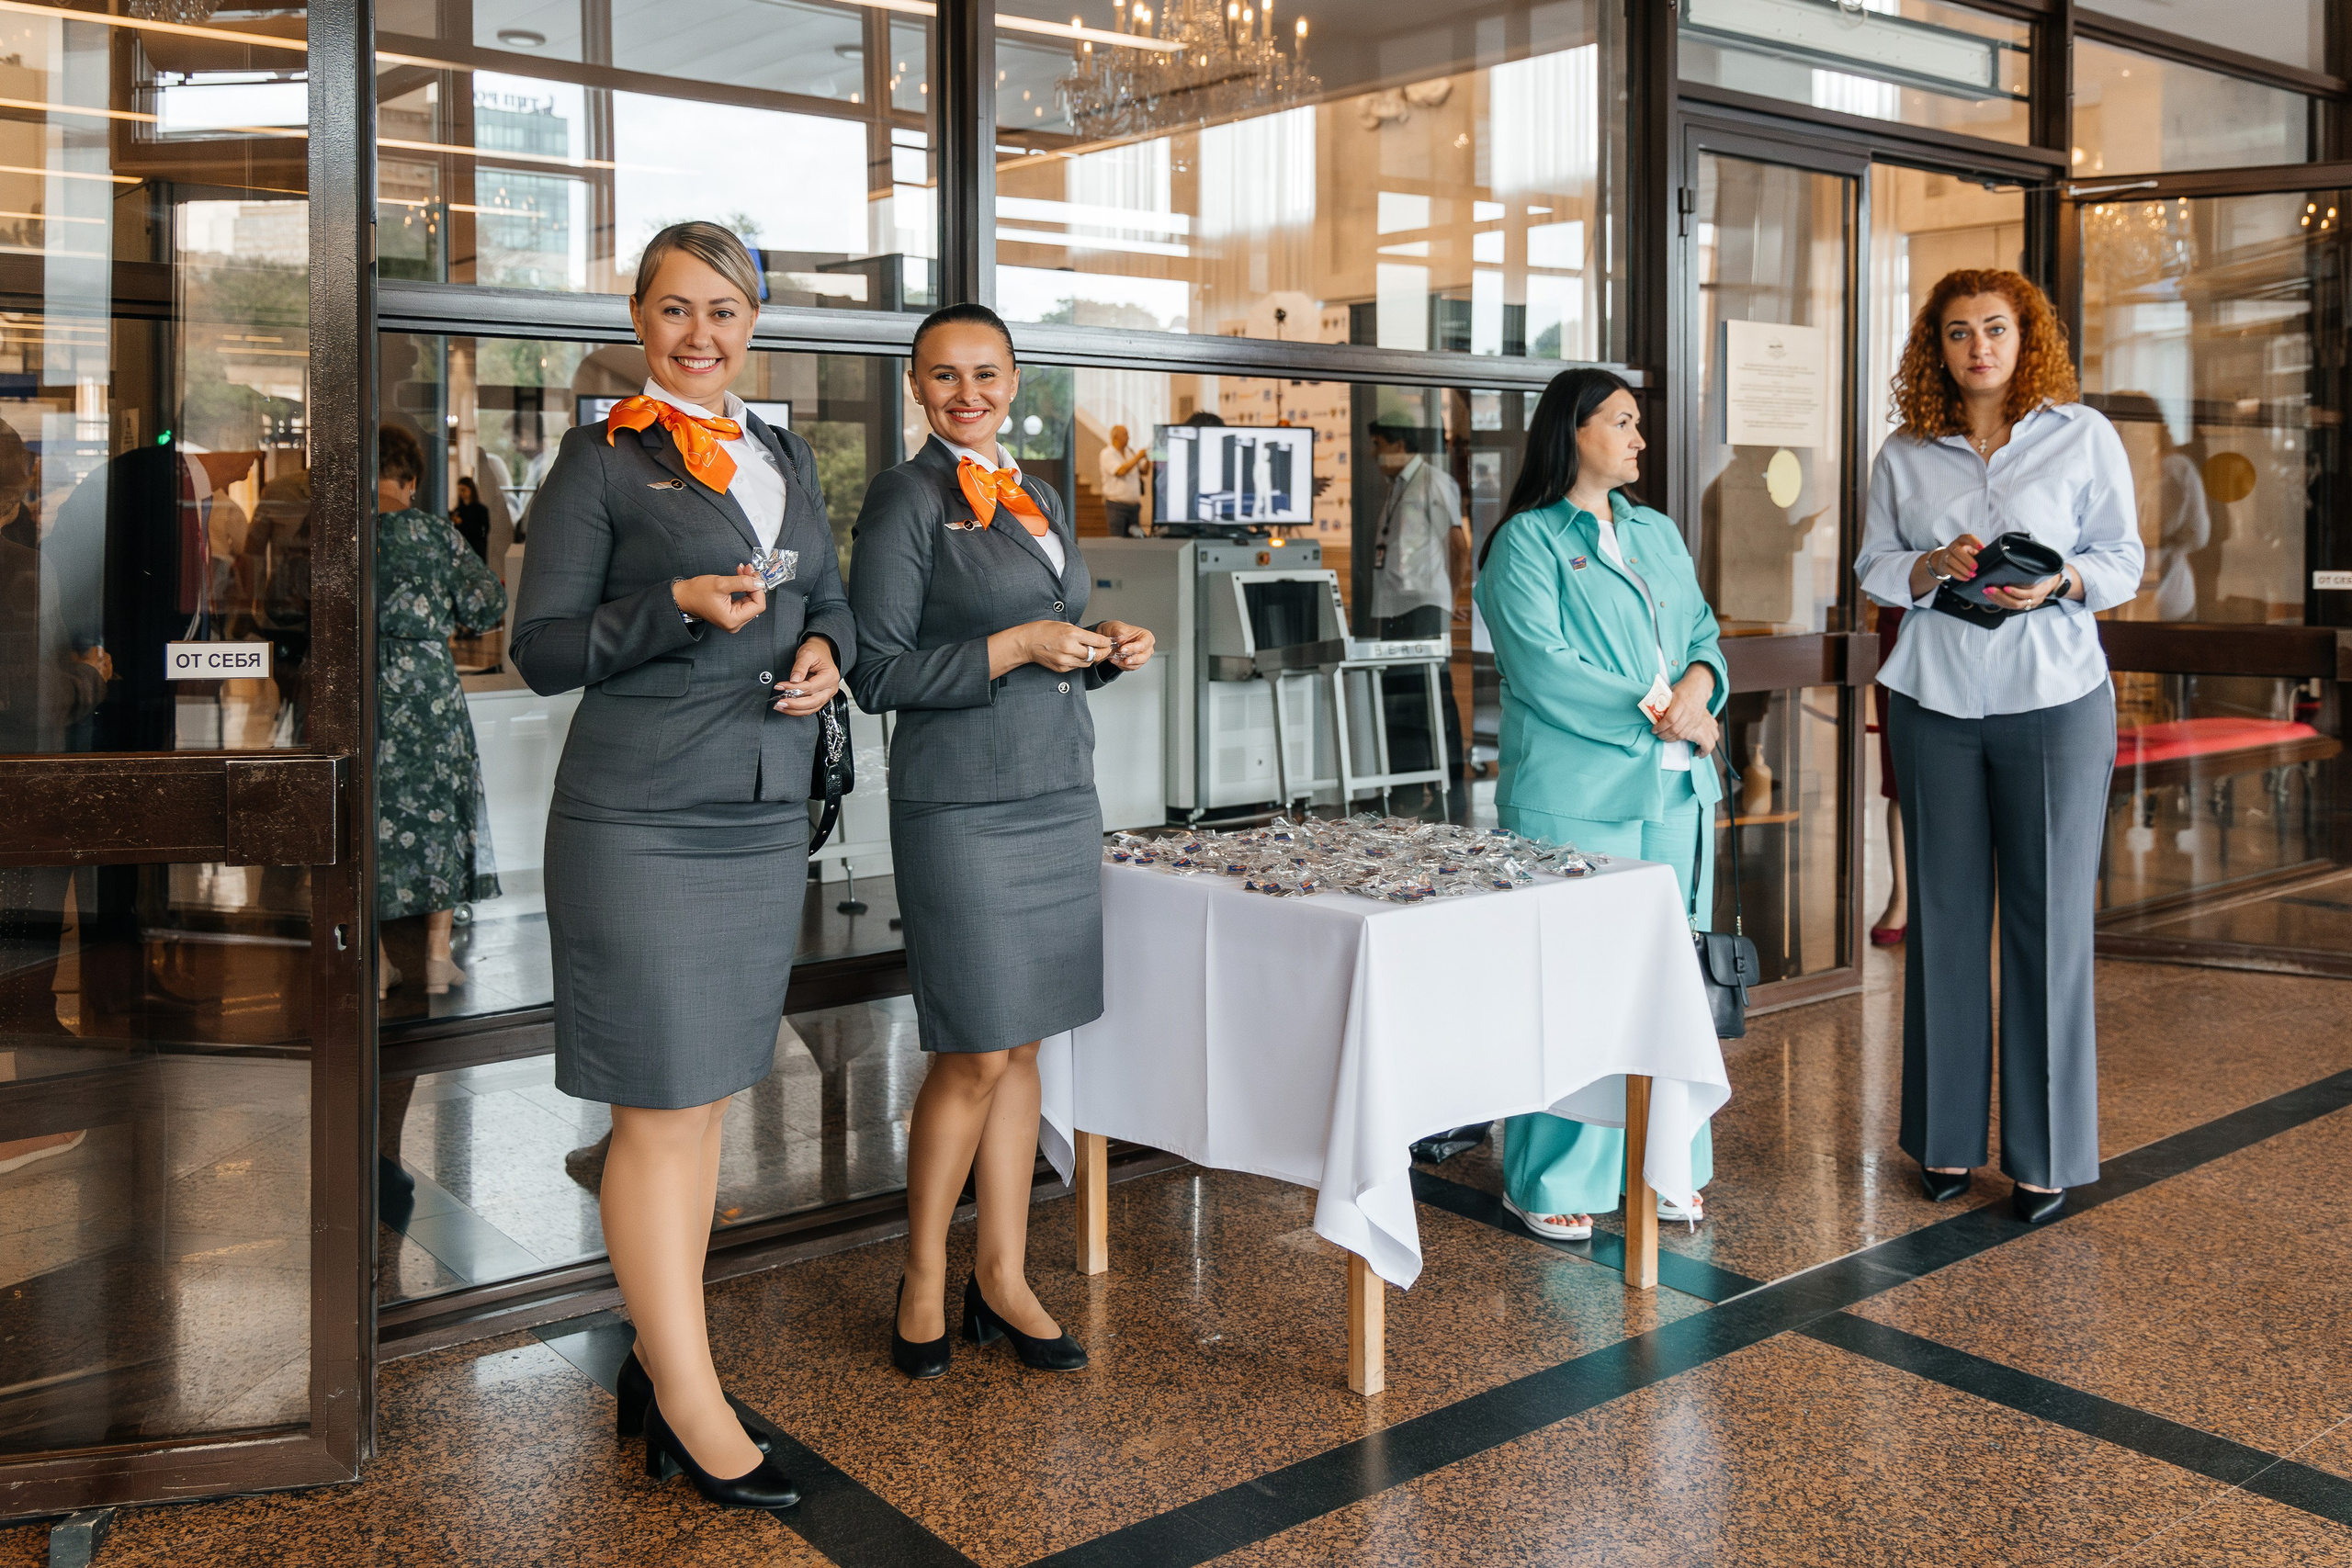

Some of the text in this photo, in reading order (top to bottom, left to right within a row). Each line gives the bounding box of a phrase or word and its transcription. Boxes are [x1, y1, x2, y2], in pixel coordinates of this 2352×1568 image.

[1374, 644, 1423, 656] BERG
[175, 653, 261, 669] ОТ СЕБЯ
